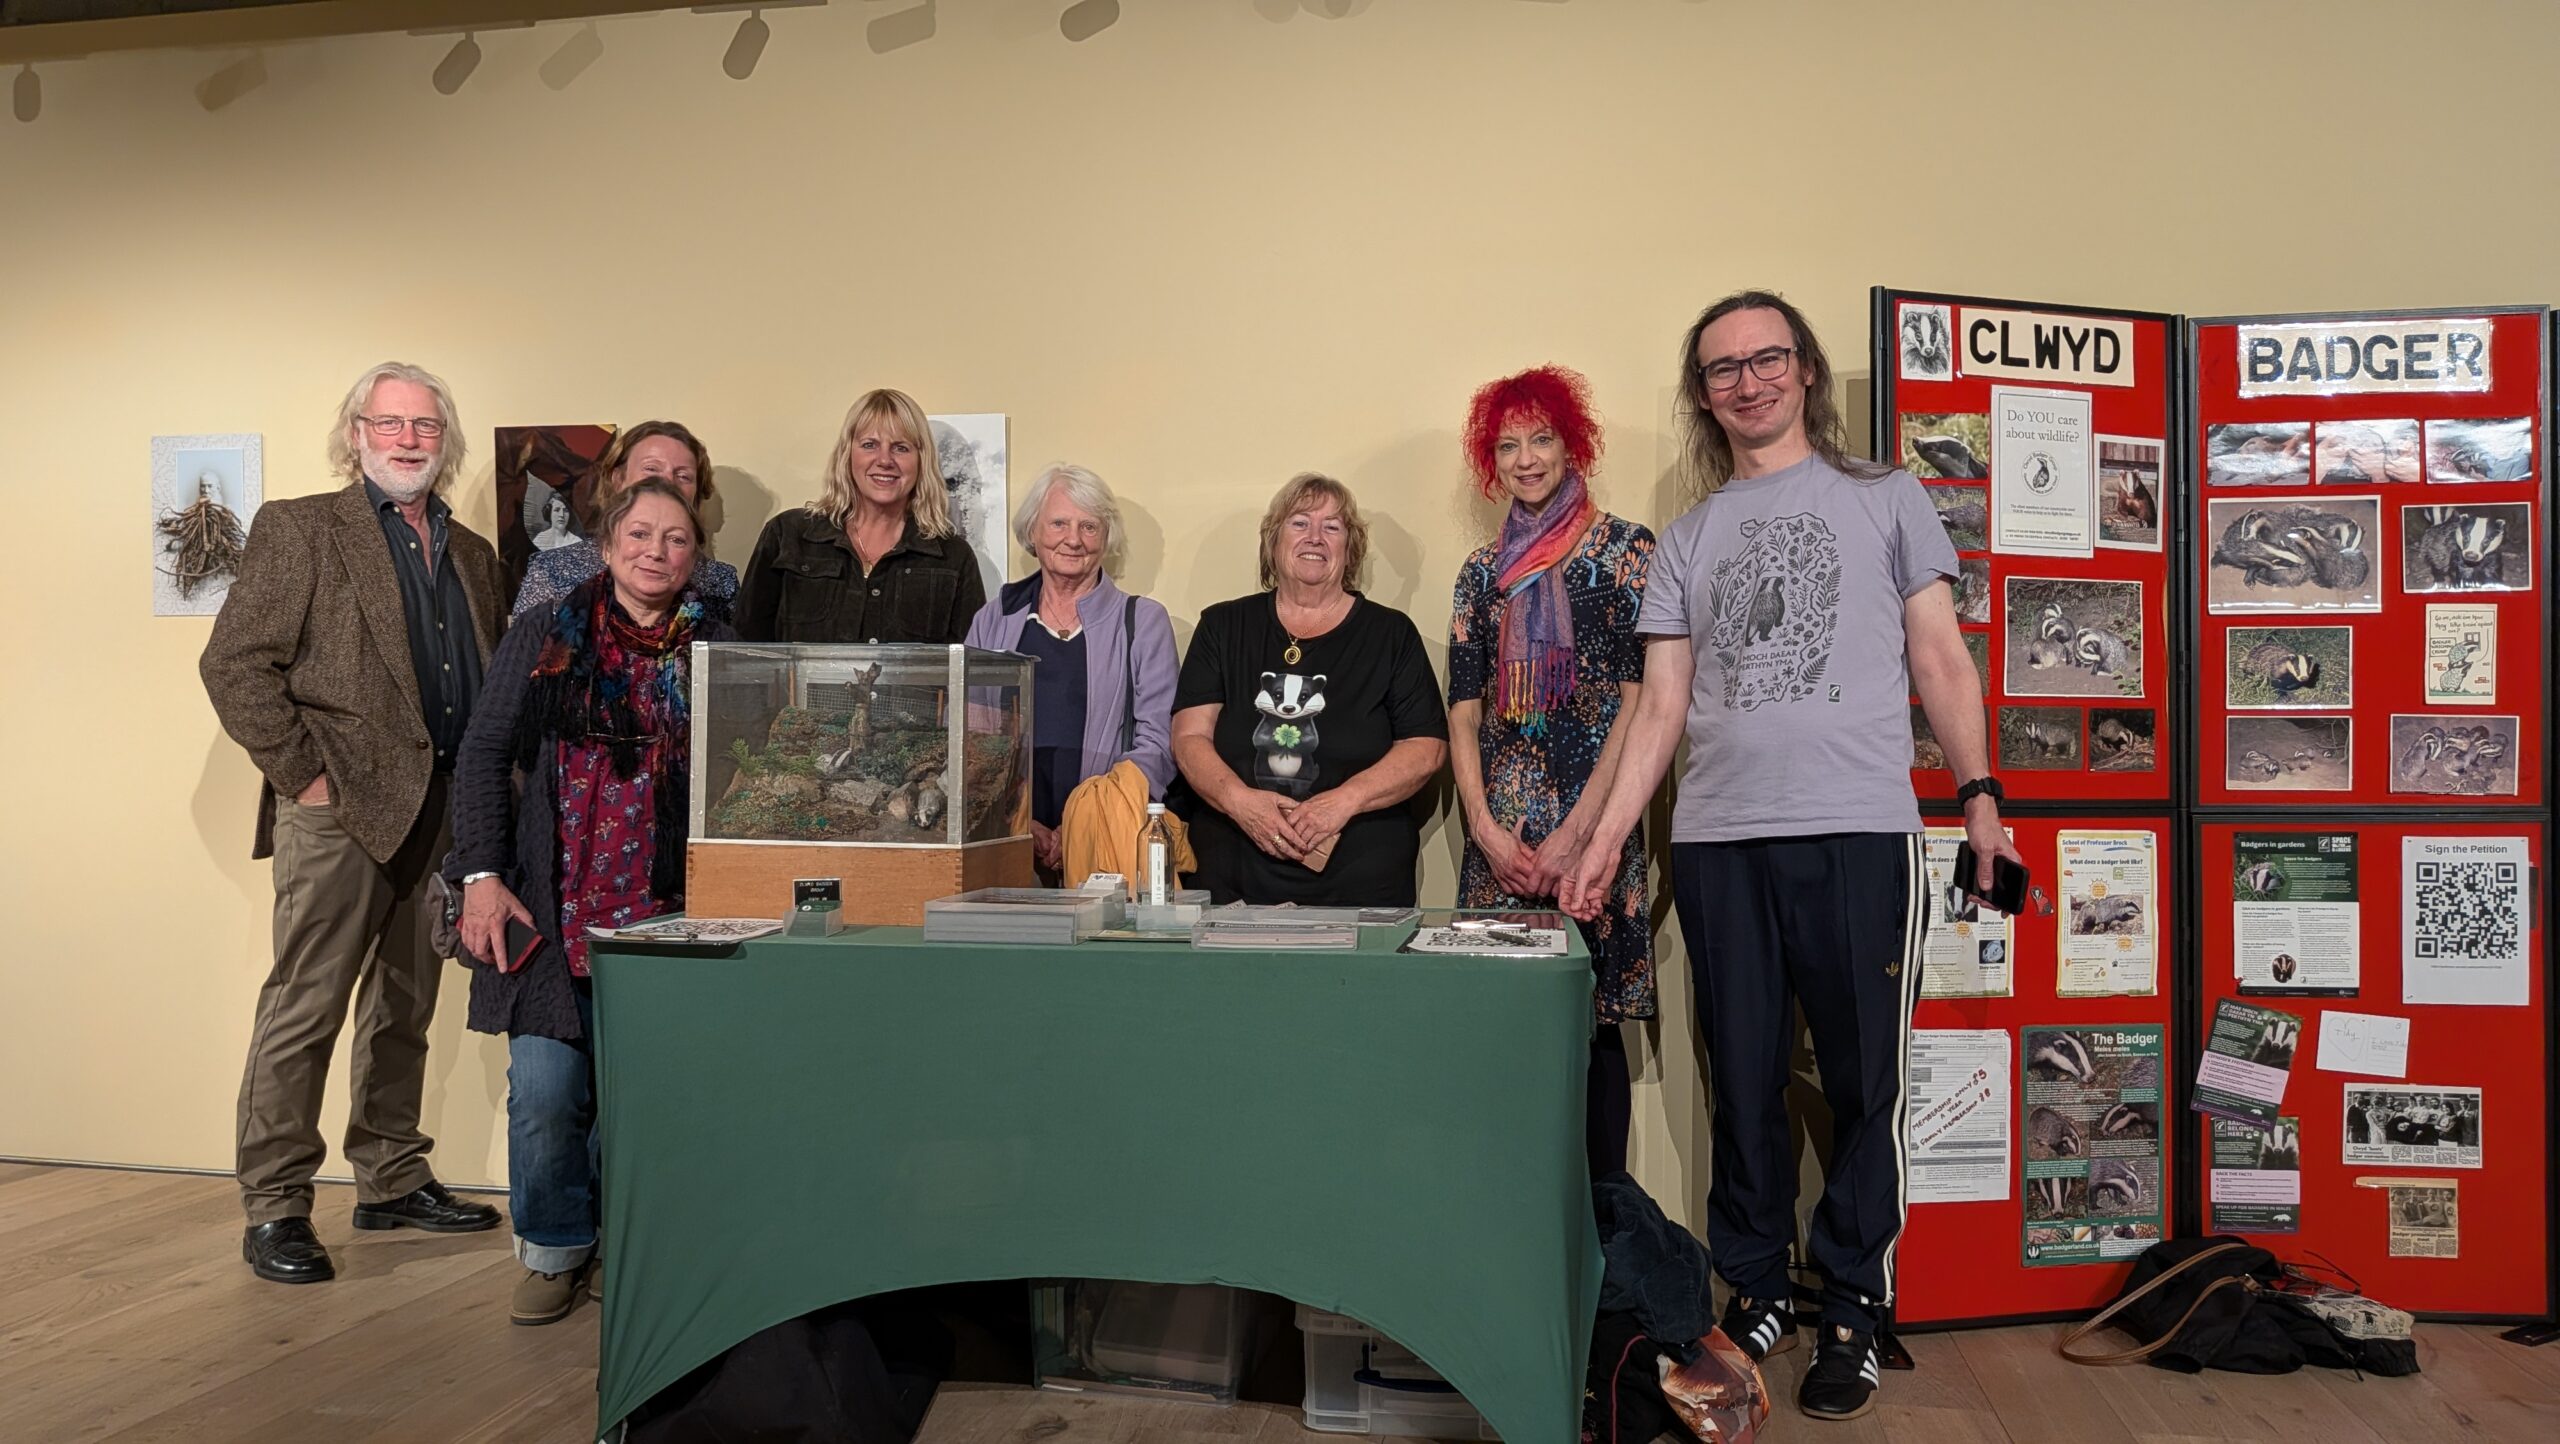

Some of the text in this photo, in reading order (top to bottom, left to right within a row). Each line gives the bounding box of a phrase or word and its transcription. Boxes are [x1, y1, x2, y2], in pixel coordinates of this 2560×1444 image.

[1969, 318, 2121, 374] CLWYD
[2247, 332, 2484, 382] BADGER
[2007, 409, 2078, 426] Do YOU care
[2006, 426, 2080, 443] about wildlife?
[1742, 650, 1797, 662] MOCH DAEAR
[1774, 658, 1794, 667] YMA
[2241, 841, 2268, 849] Badgers
[2277, 841, 2306, 849] gardens
[2331, 836, 2351, 844] SPACE
[2425, 844, 2508, 855] Sign the Petition
[2092, 1032, 2158, 1047] The Badger
[1912, 1097, 1952, 1131] MEMBERSHIP
[1955, 1081, 1972, 1098] ONLY
[1947, 1100, 1963, 1113] YEAR
[1920, 1127, 1943, 1146] FAMILY
[2040, 1242, 2100, 1251] www.badgerland.co.uk
